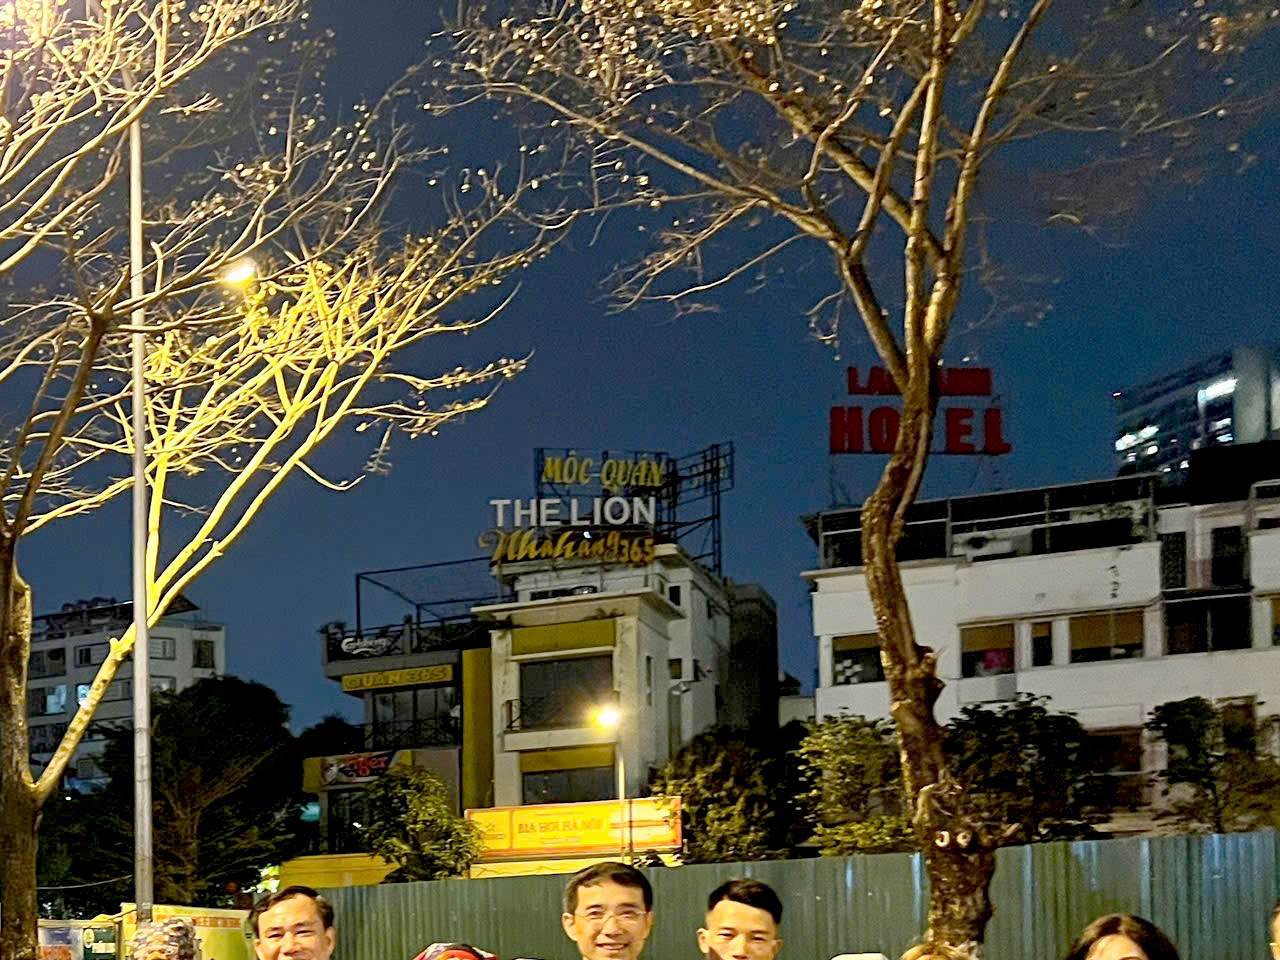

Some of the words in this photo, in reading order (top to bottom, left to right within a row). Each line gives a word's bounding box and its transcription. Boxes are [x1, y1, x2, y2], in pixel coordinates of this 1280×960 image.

[830, 406, 1012, 455] HOEL
[489, 498, 562, 528] THE
[569, 496, 656, 526] LION
[619, 537, 656, 564] 365
